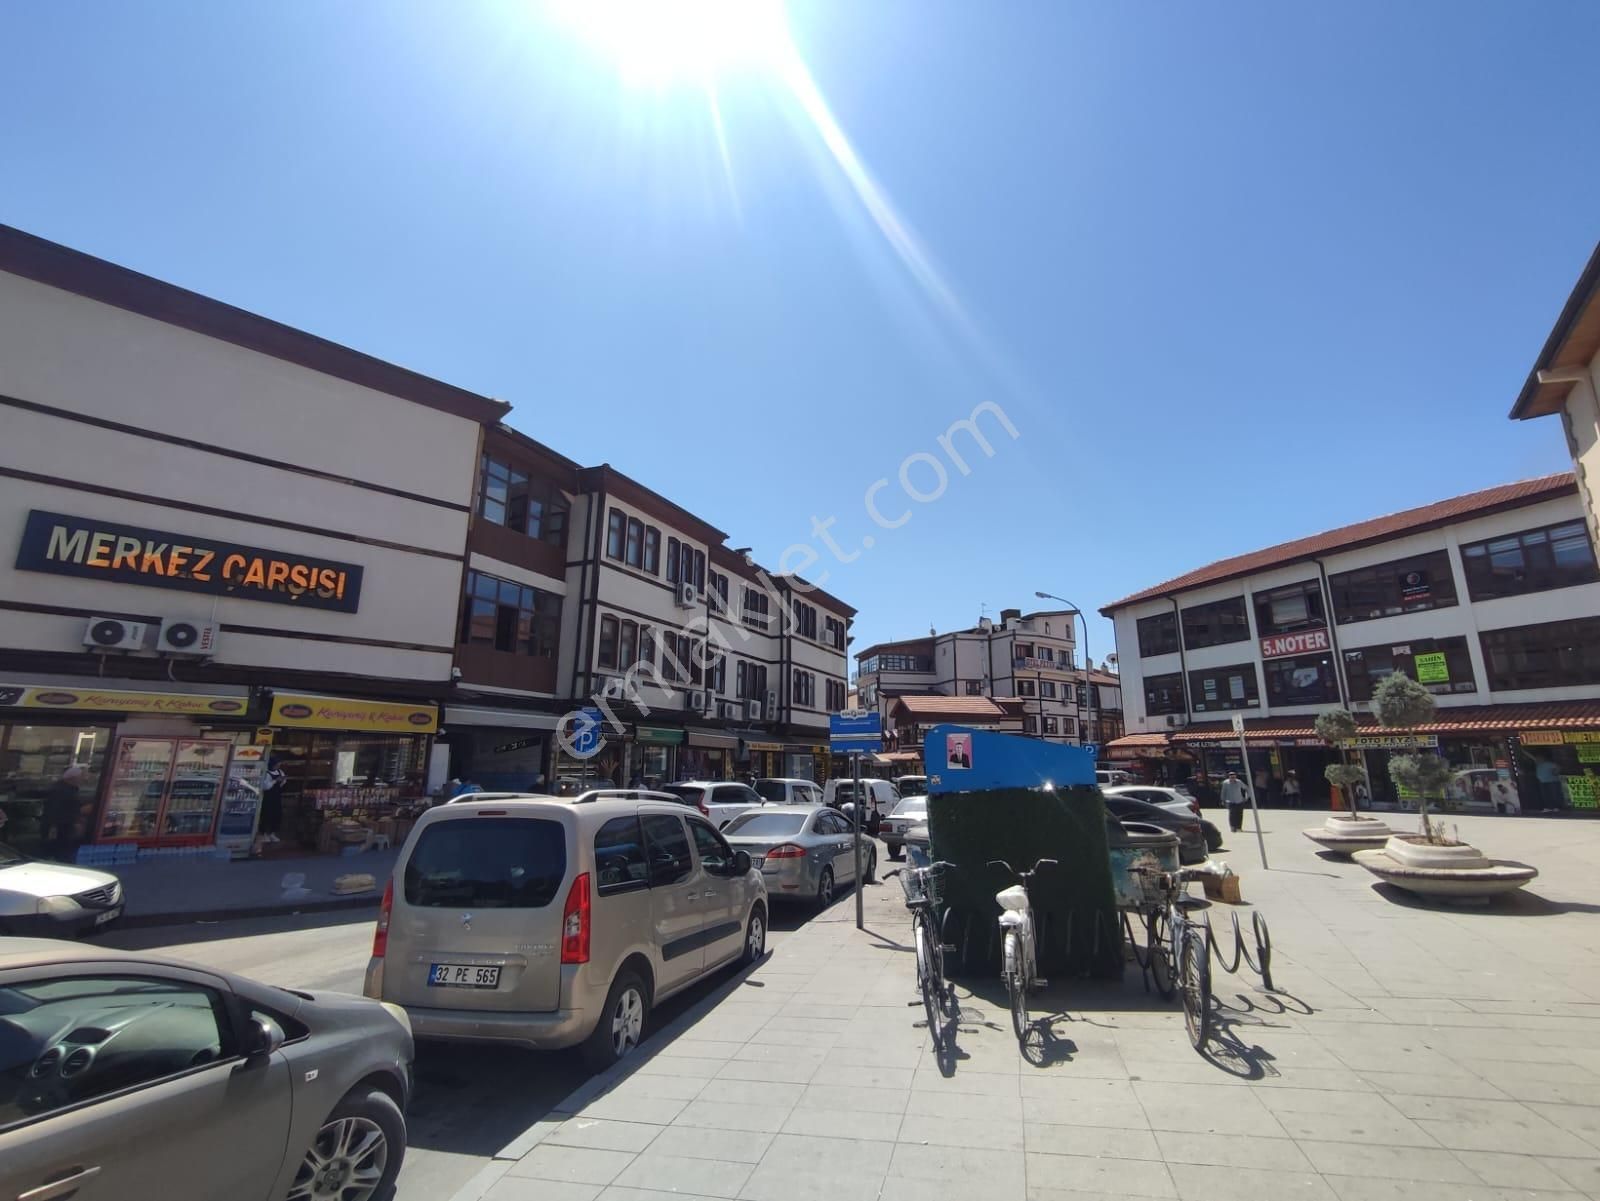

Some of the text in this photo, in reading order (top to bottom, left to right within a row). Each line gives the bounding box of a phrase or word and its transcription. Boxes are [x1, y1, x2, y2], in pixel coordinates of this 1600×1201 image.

[46, 525, 347, 600] MERKEZ ÇARŞISI
[1263, 632, 1328, 656] 5.NOTER
[1296, 738, 1326, 746] TABELA
[1355, 737, 1380, 745] FOTO
[435, 967, 497, 983] 32 PE 565
